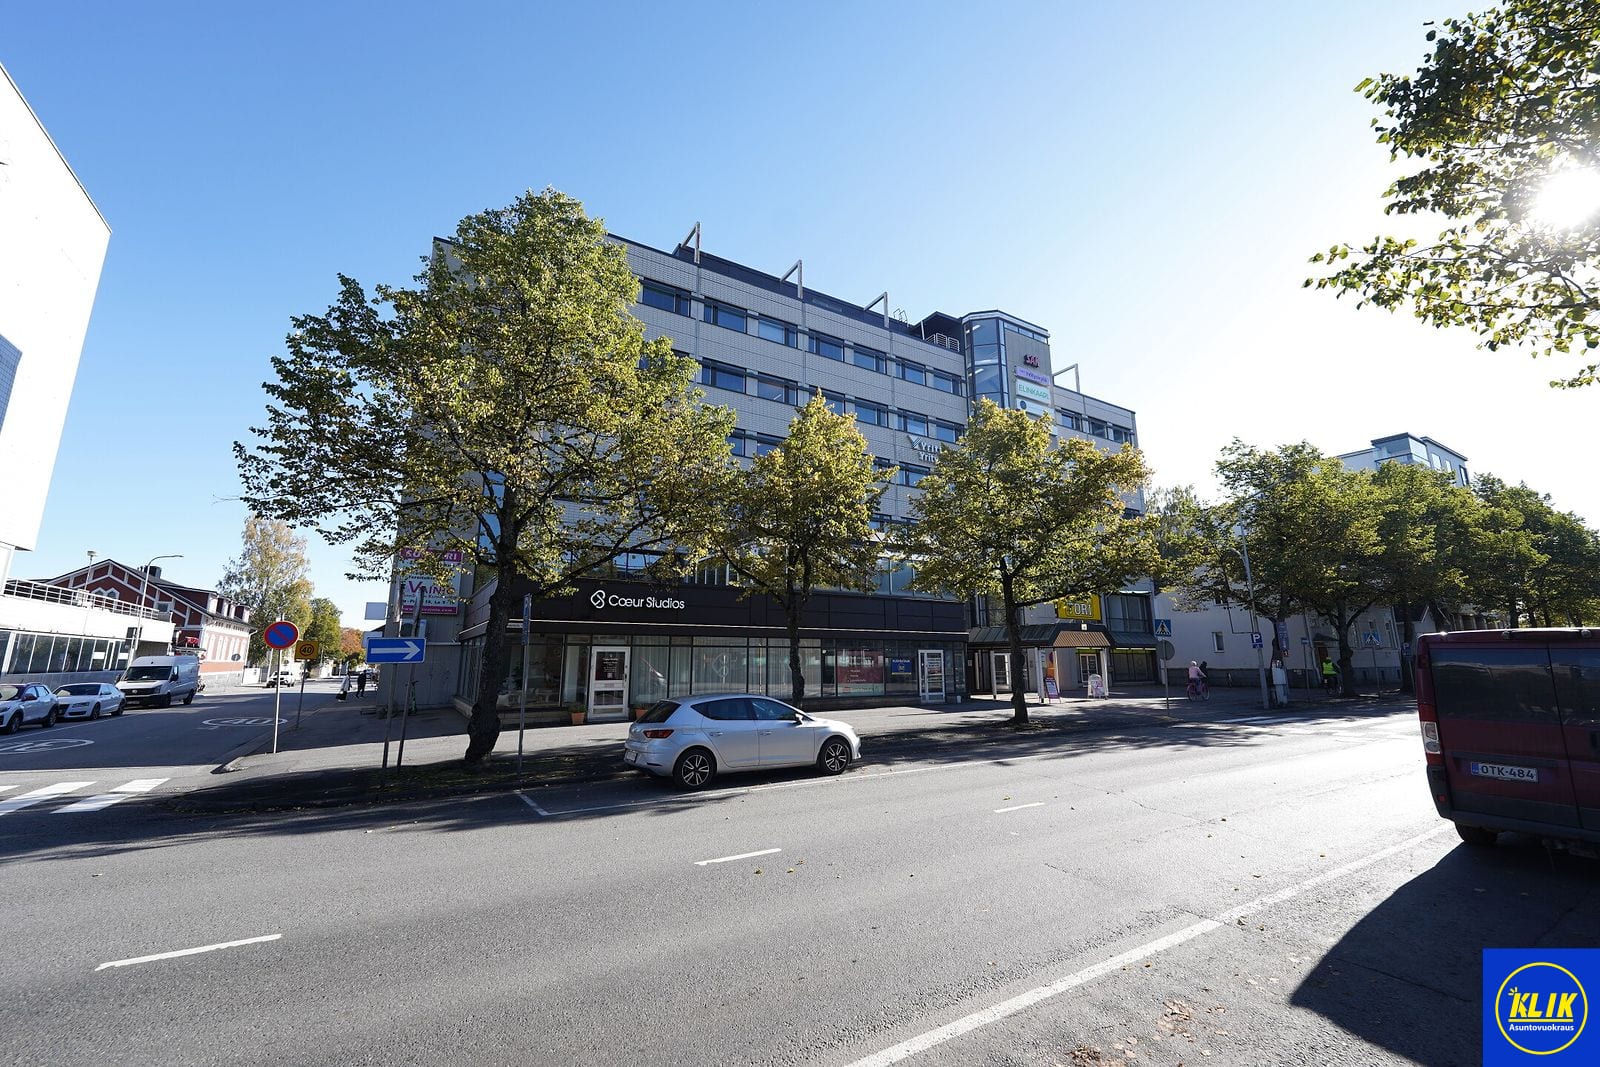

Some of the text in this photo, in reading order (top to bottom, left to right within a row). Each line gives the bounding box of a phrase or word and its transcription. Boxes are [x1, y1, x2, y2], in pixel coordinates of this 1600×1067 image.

[608, 595, 685, 609] Cœur Studios
[301, 646, 313, 654] 40
[1481, 765, 1535, 780] OTK-484
